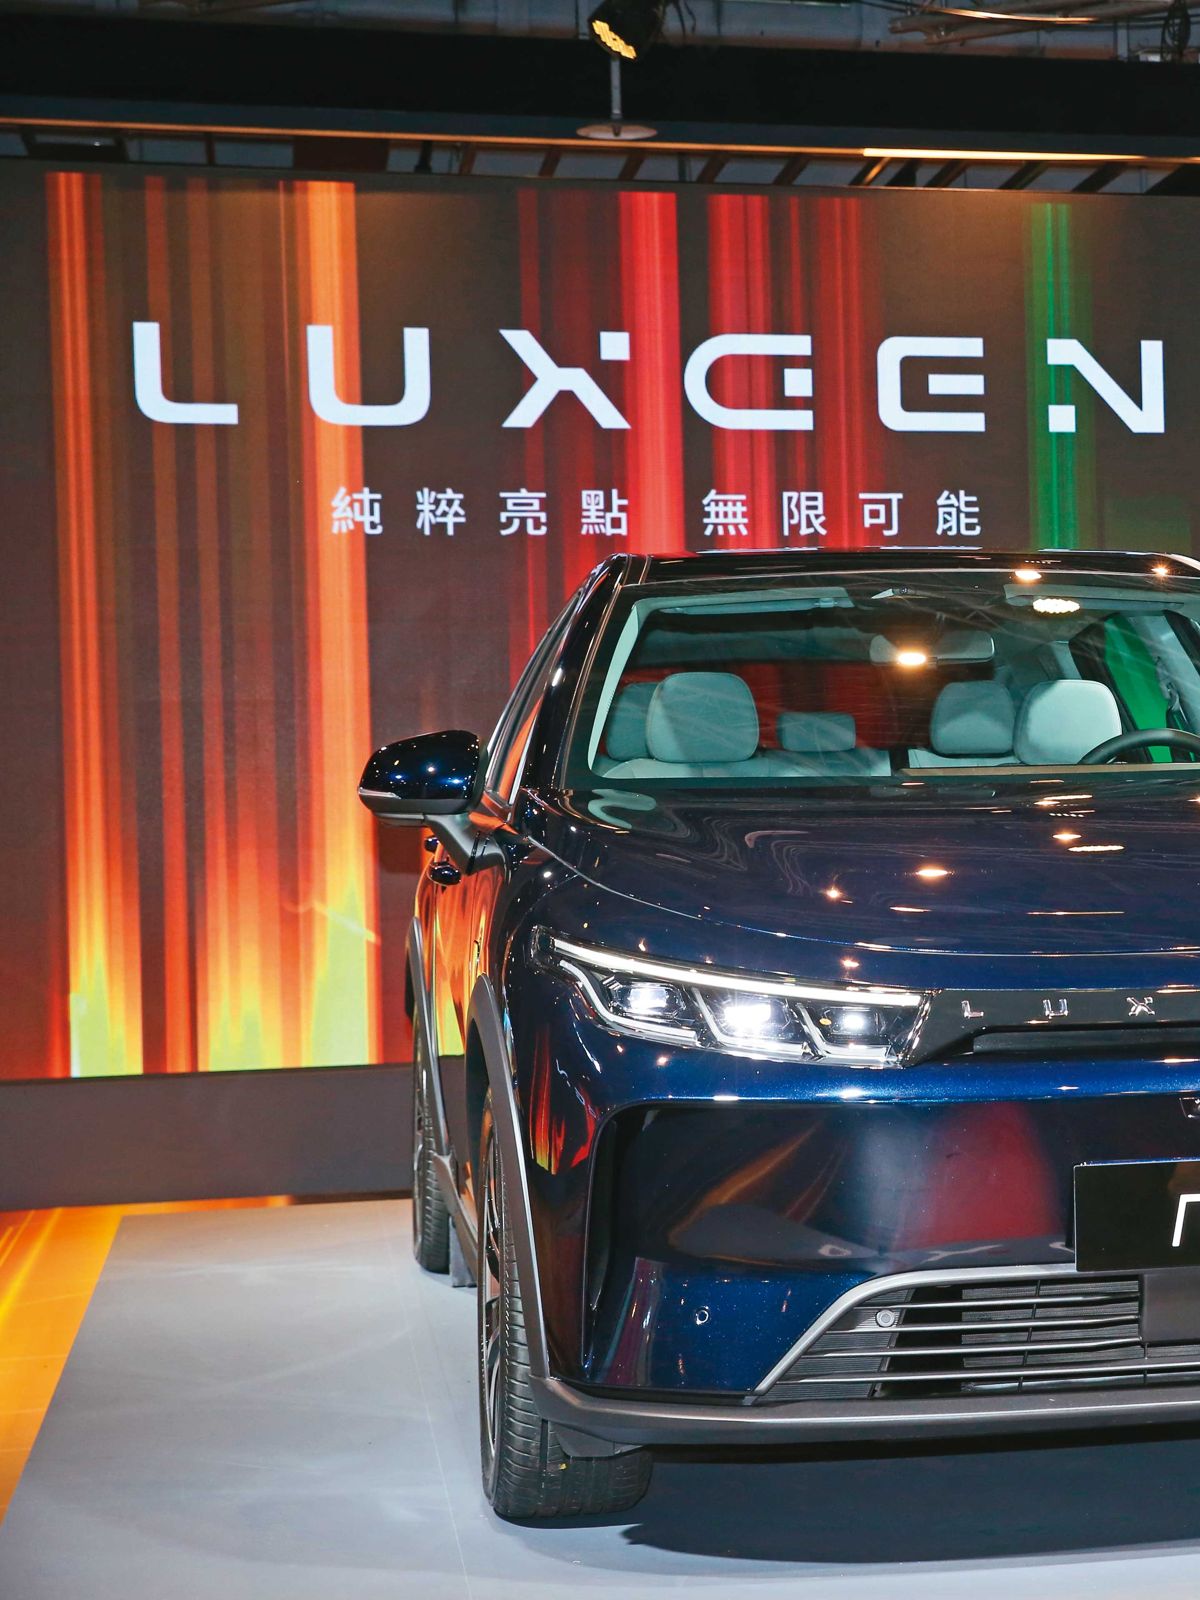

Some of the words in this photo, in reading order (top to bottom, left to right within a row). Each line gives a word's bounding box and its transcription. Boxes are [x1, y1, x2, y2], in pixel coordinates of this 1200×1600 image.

[134, 322, 1165, 433] LUXGEN
[332, 487, 628, 535] 純粹亮點
[702, 490, 981, 535] 無限可能
